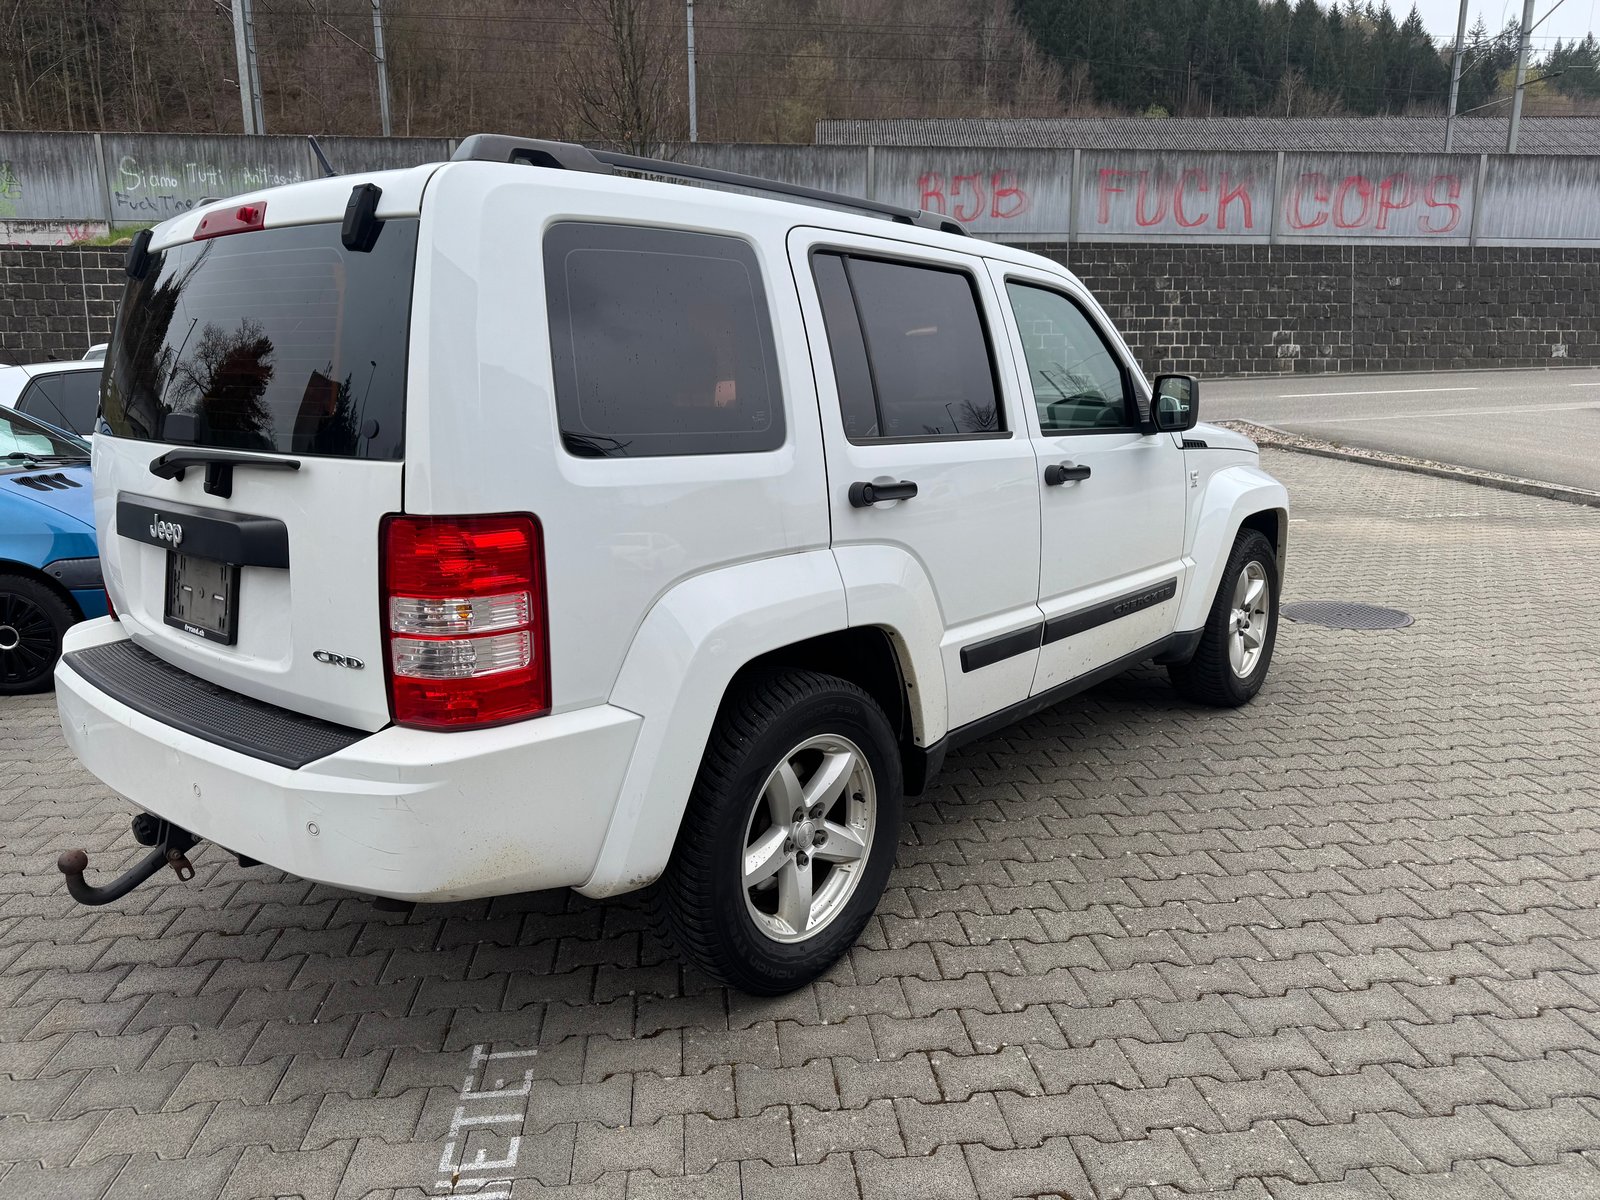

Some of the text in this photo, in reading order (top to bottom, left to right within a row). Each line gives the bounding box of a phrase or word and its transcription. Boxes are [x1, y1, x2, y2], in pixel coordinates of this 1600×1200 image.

[120, 155, 177, 191] Siamo
[115, 191, 158, 211] Fuck
[1097, 168, 1253, 230] FUCK
[1286, 172, 1461, 233] COPS
[150, 513, 183, 547] Jeep
[1113, 586, 1171, 615] CHEROKEE
[312, 648, 365, 670] CRD
